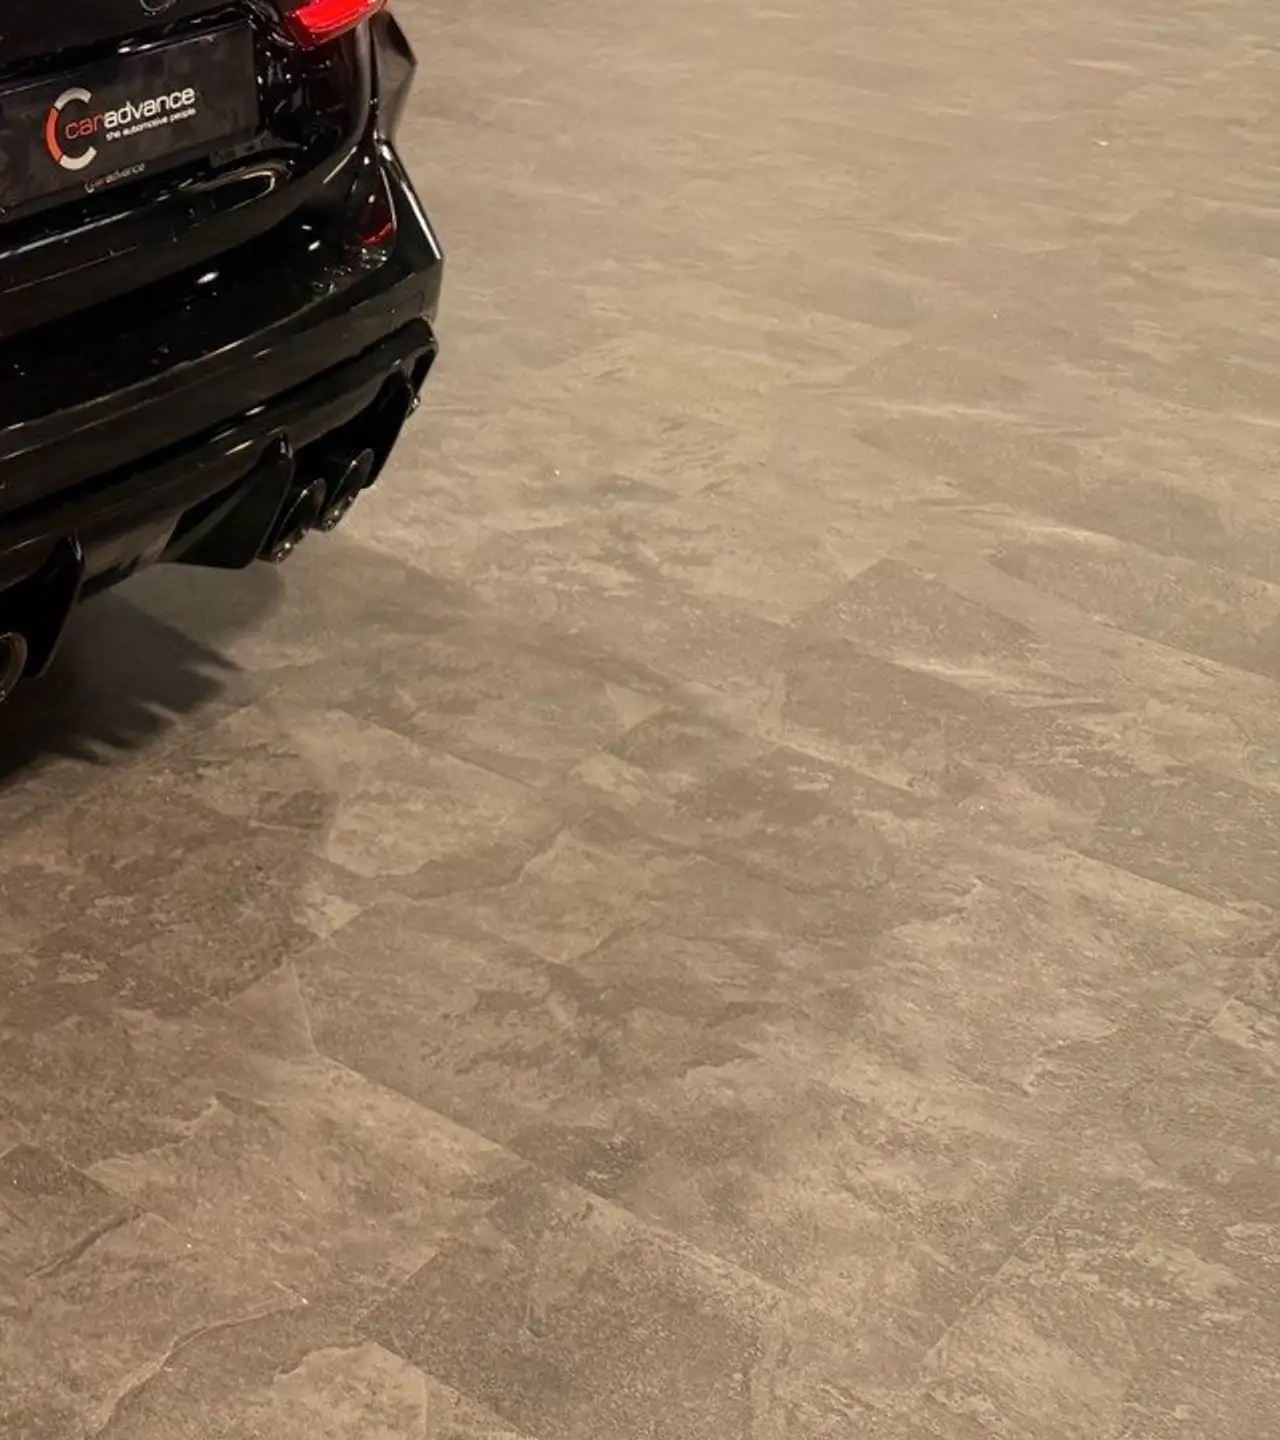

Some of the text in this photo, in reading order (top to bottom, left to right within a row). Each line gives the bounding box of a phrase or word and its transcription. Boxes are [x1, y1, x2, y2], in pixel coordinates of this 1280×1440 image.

[65, 87, 196, 140] caradvance
[105, 130, 122, 142] the
[123, 115, 169, 136] automotive
